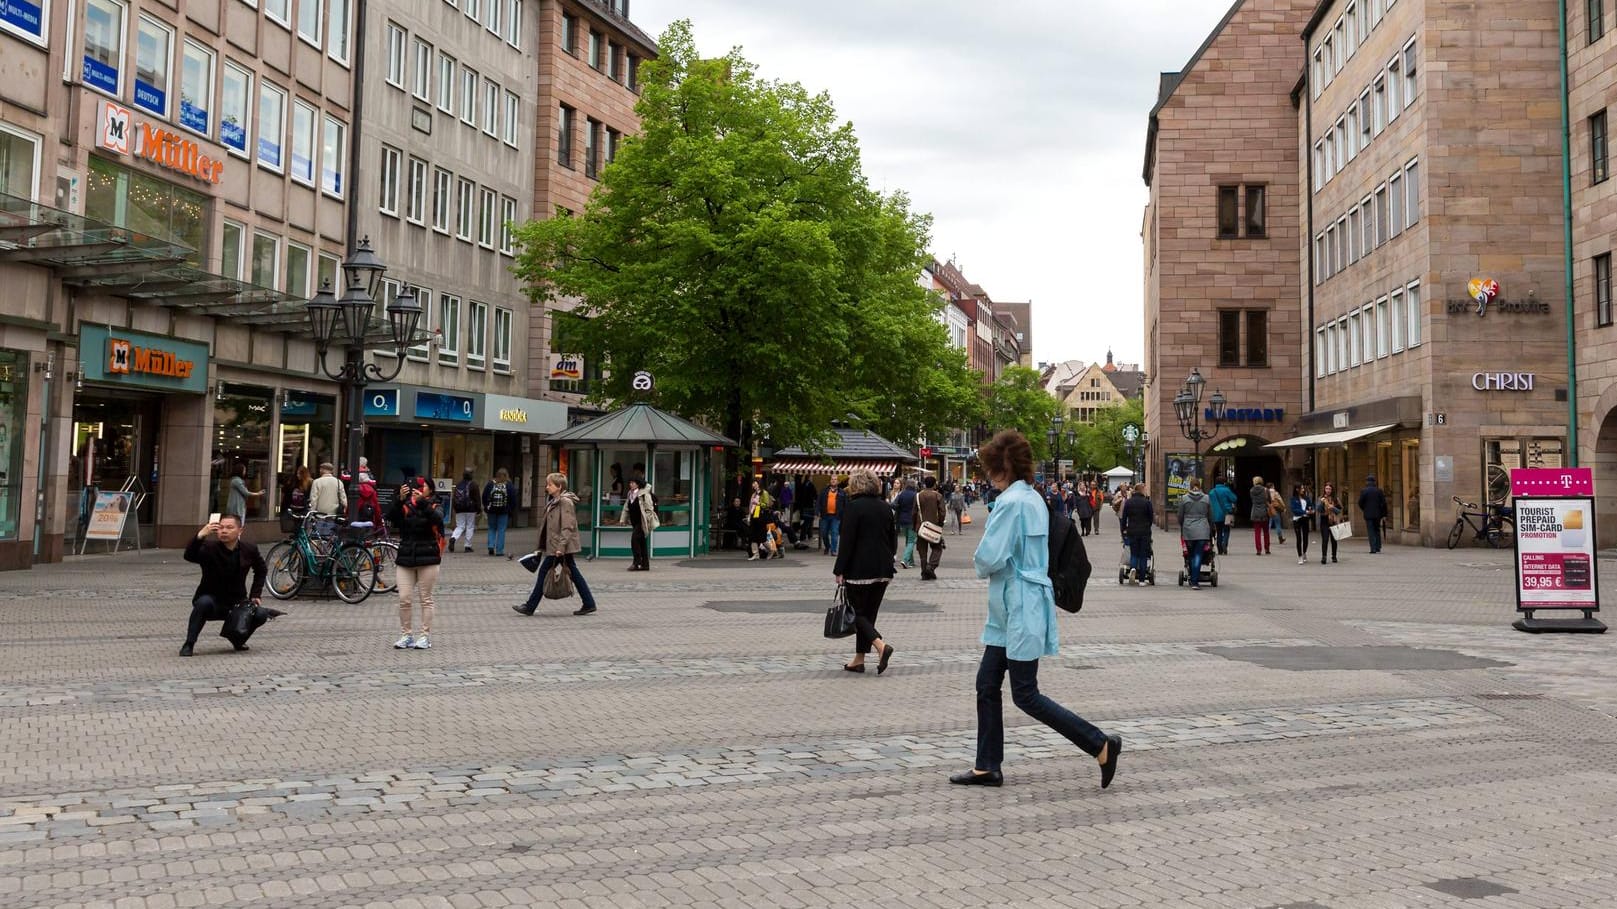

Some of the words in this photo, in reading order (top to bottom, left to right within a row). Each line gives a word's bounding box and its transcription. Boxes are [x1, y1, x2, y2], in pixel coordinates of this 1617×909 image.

[8, 4, 38, 25] MULTI-MEDIA
[91, 68, 116, 86] MULTI-MEDIA
[137, 87, 160, 107] DEUTSCH
[135, 121, 224, 185] Müller
[134, 346, 193, 378] Müller
[556, 355, 577, 370] dm
[1472, 372, 1536, 391] CHRIST
[1438, 414, 1444, 424] 6
[1560, 475, 1572, 489] T
[1520, 507, 1554, 515] TOURIST
[1520, 524, 1562, 532] SIM-CARD
[1524, 576, 1552, 588] 39,95
[1555, 576, 1561, 587] €
